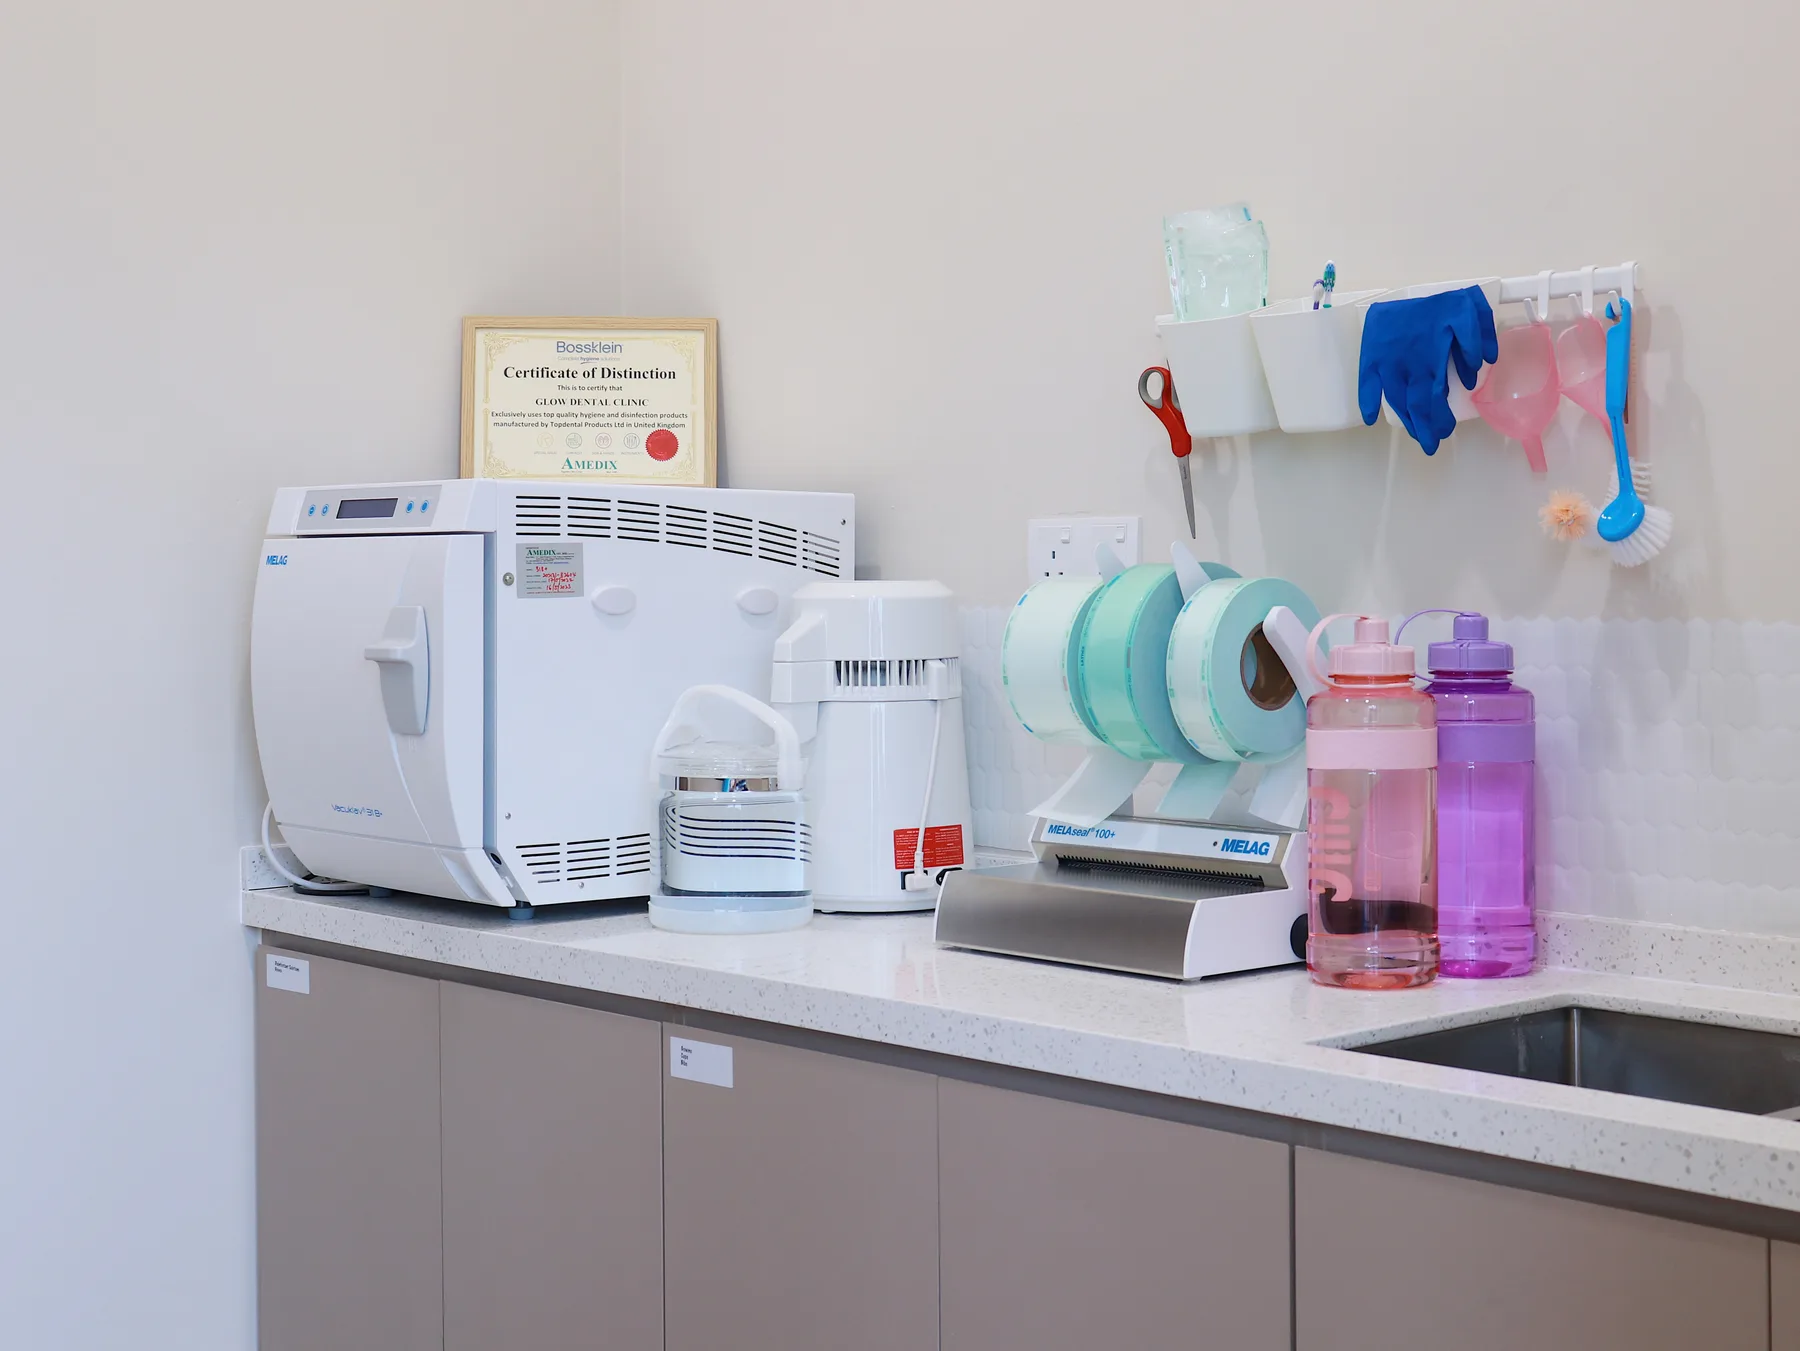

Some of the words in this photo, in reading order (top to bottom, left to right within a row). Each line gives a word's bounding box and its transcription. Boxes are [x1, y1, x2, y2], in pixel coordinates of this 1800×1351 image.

[556, 341, 623, 353] Bossklein
[503, 366, 578, 379] Certificate
[582, 367, 598, 379] of
[601, 367, 676, 380] Distinction
[586, 385, 607, 393] certify
[535, 398, 566, 406] GLOW
[570, 398, 610, 406] DENTAL
[613, 398, 649, 406] CLINIC
[579, 411, 605, 419] hygiene
[657, 422, 686, 430] Kingdom
[561, 457, 617, 469] AMEDIX
[266, 555, 288, 566] MELAG
[1095, 828, 1116, 839] 100+
[1220, 838, 1270, 856] MELAG
